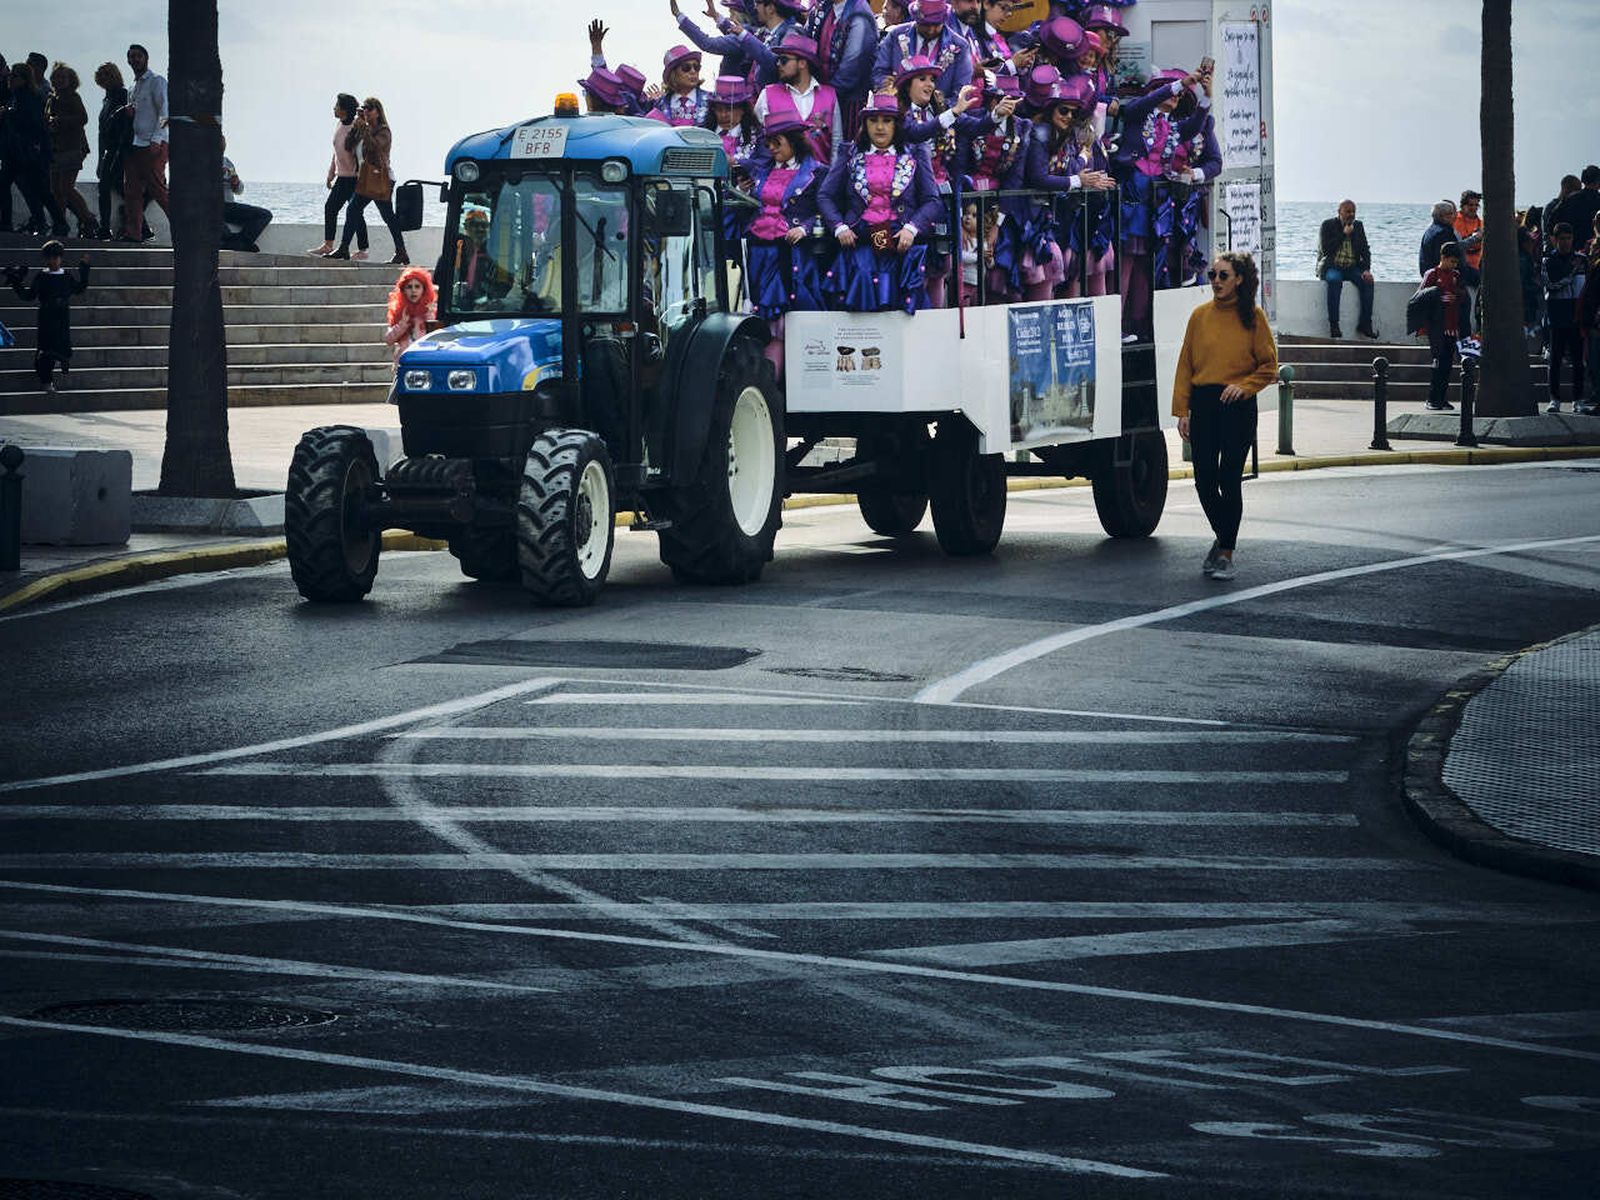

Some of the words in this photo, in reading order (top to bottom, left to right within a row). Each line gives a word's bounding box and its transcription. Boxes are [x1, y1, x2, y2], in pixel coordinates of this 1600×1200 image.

[518, 129, 528, 140] E
[532, 128, 563, 139] 2155
[525, 142, 551, 155] BFB
[708, 1046, 1471, 1111] HOTEL
